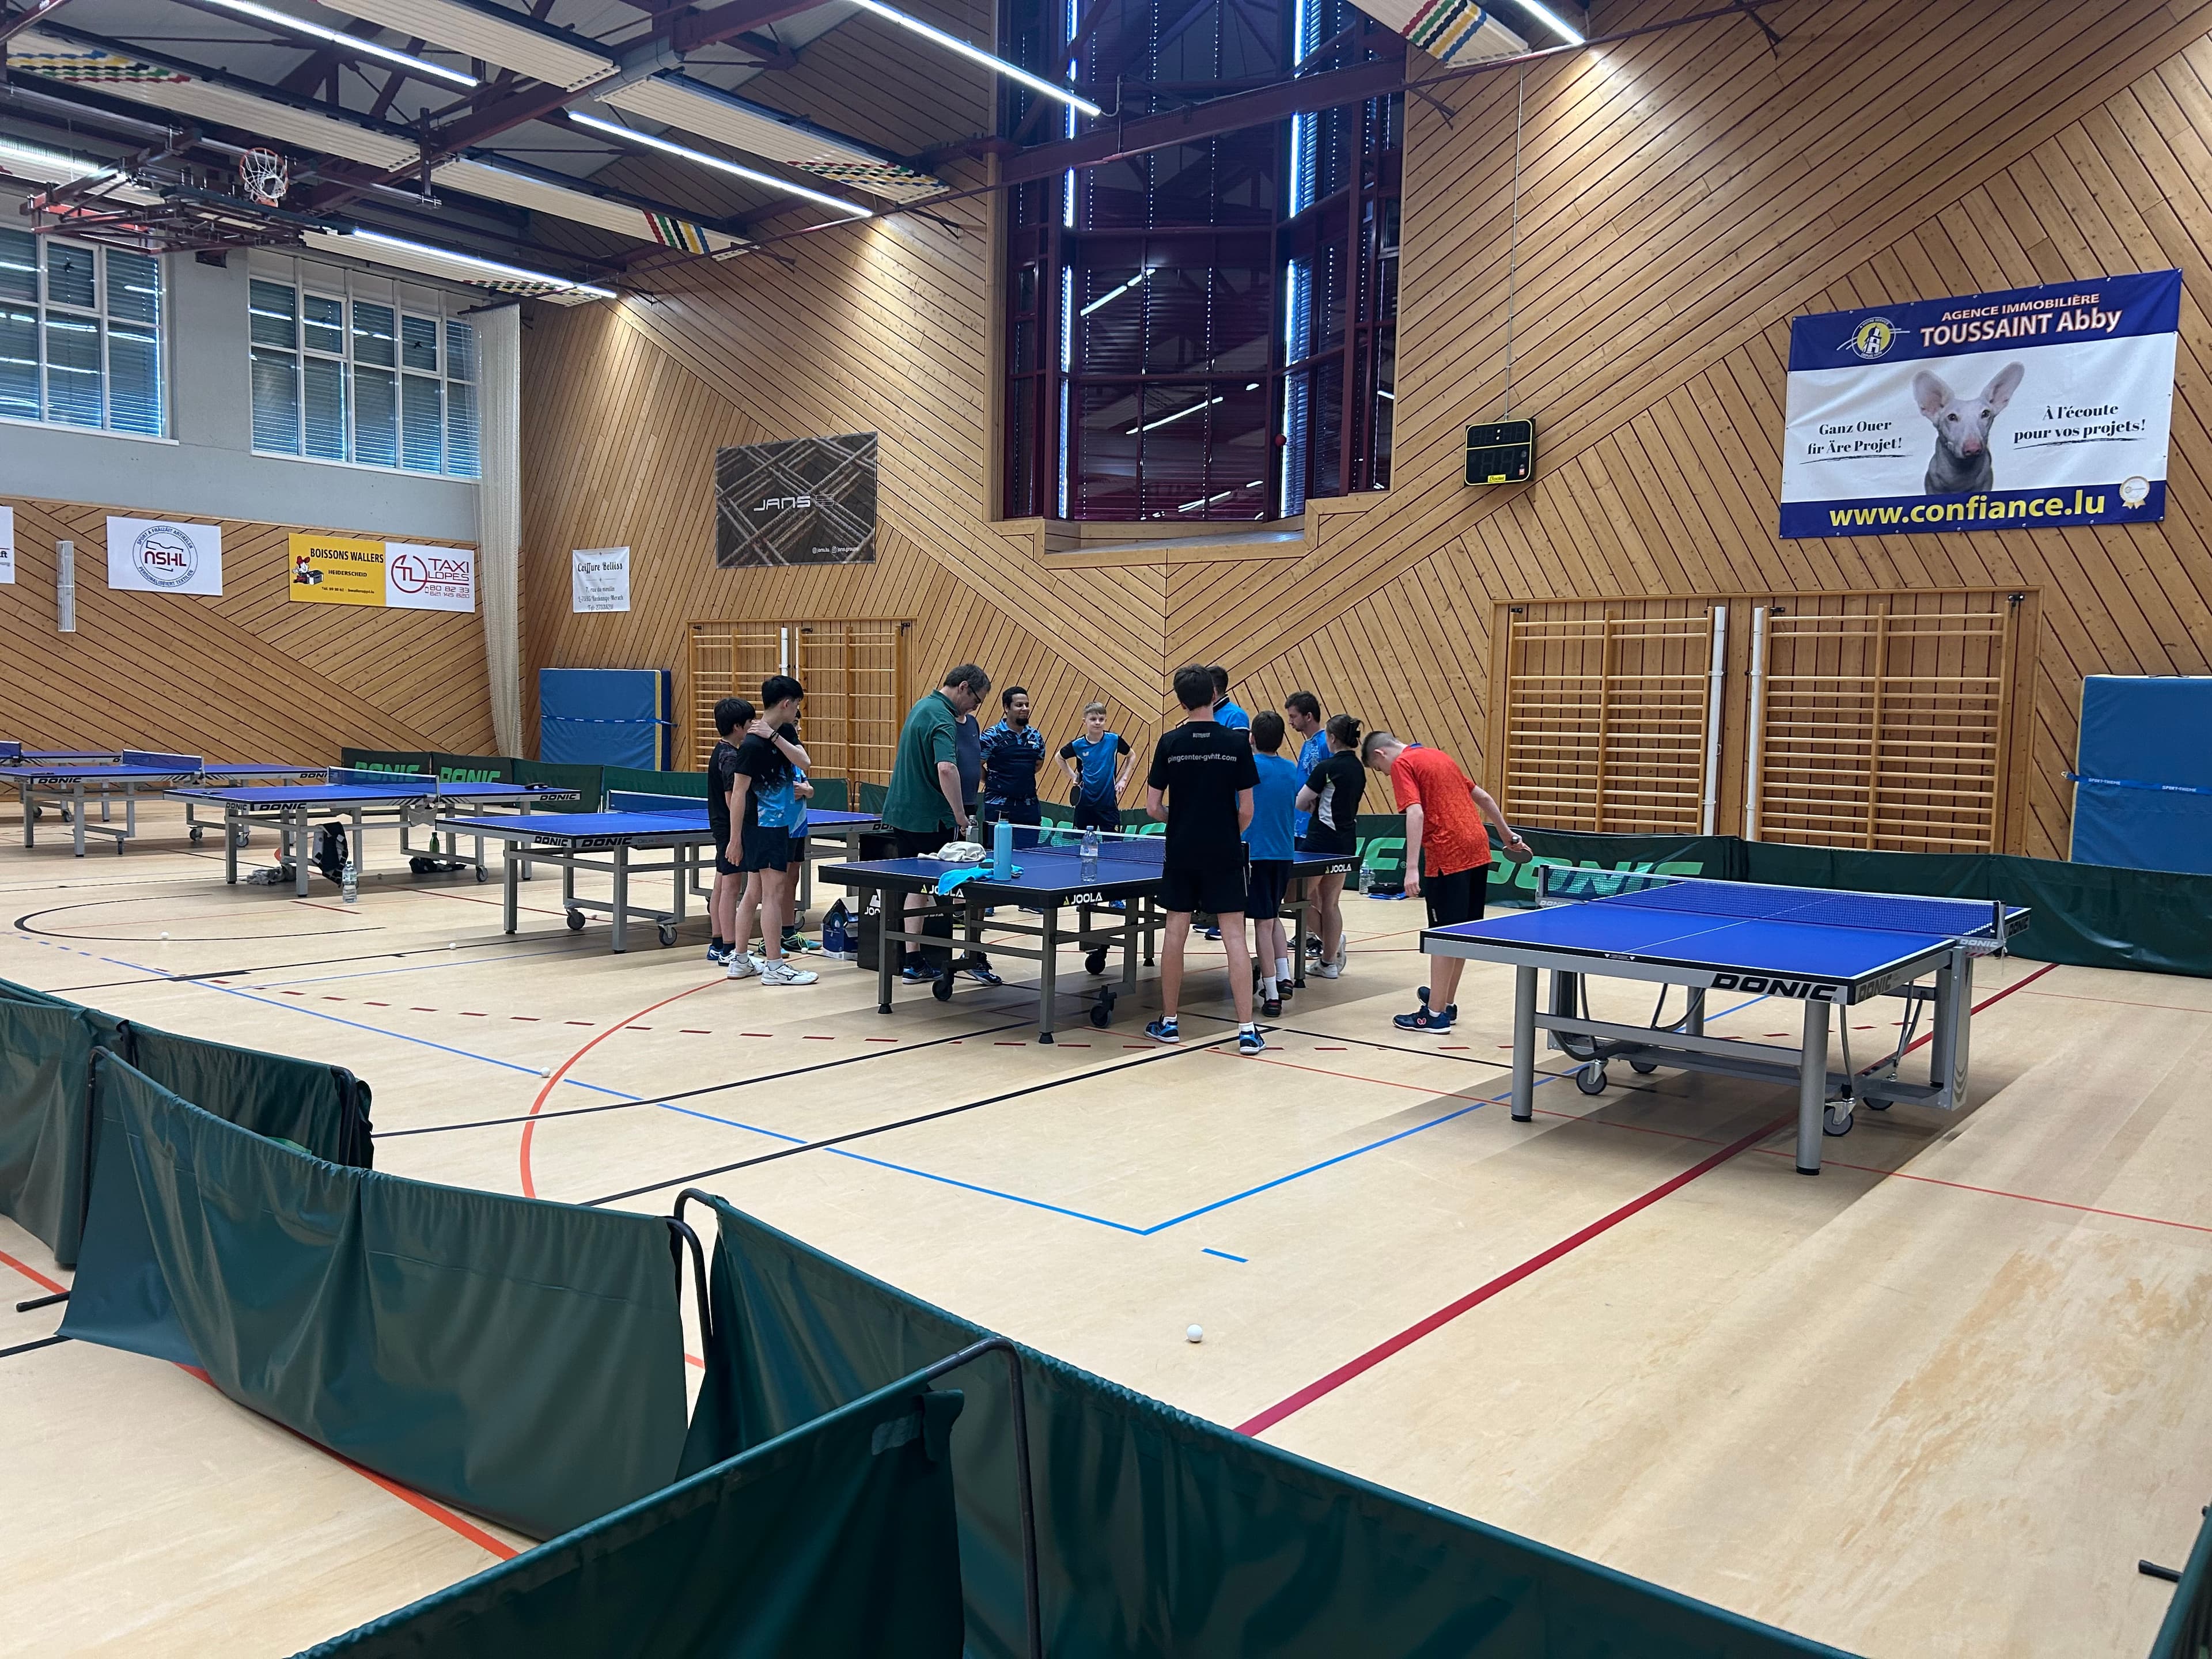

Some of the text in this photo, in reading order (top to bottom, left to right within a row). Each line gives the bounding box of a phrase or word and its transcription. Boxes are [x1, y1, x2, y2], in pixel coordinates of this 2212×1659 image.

[1942, 293, 2100, 321] AGENCE IMMOBILIÈRE
[1920, 307, 2122, 347] TOUSSAINT Abby
[2042, 404, 2119, 421] À l'écoute
[1819, 421, 1892, 435] Ganz Ouer
[2014, 419, 2146, 444] pour vos projets!
[1808, 437, 1902, 454] fir Äre Projet!
[753, 495, 810, 512] JANS
[1829, 489, 2105, 527] www.confiance.lu
[137, 533, 148, 545] SPORT
[173, 530, 194, 549] ARTIKELEN
[310, 548, 384, 563] BOISSONS WALLERS
[328, 569, 367, 577] HEIDERSCHEID
[428, 558, 469, 573] TAXI
[578, 562, 623, 574] Coiffure Belliss
[176, 570, 194, 585] TEXTILIEN
[428, 571, 469, 581] LOPES
[1168, 753, 1237, 764] pingcenter-gvhtt.com
[226, 802, 247, 810] DONIC
[535, 836, 568, 847] DONIC
[581, 837, 632, 847] DONIC
[1330, 863, 1352, 873] JOOLA
[1071, 892, 1103, 905] JOOLA
[1959, 938, 1999, 948] DONIC
[1711, 973, 1838, 1002] DONIC
[1858, 974, 1892, 1002] DONIC
